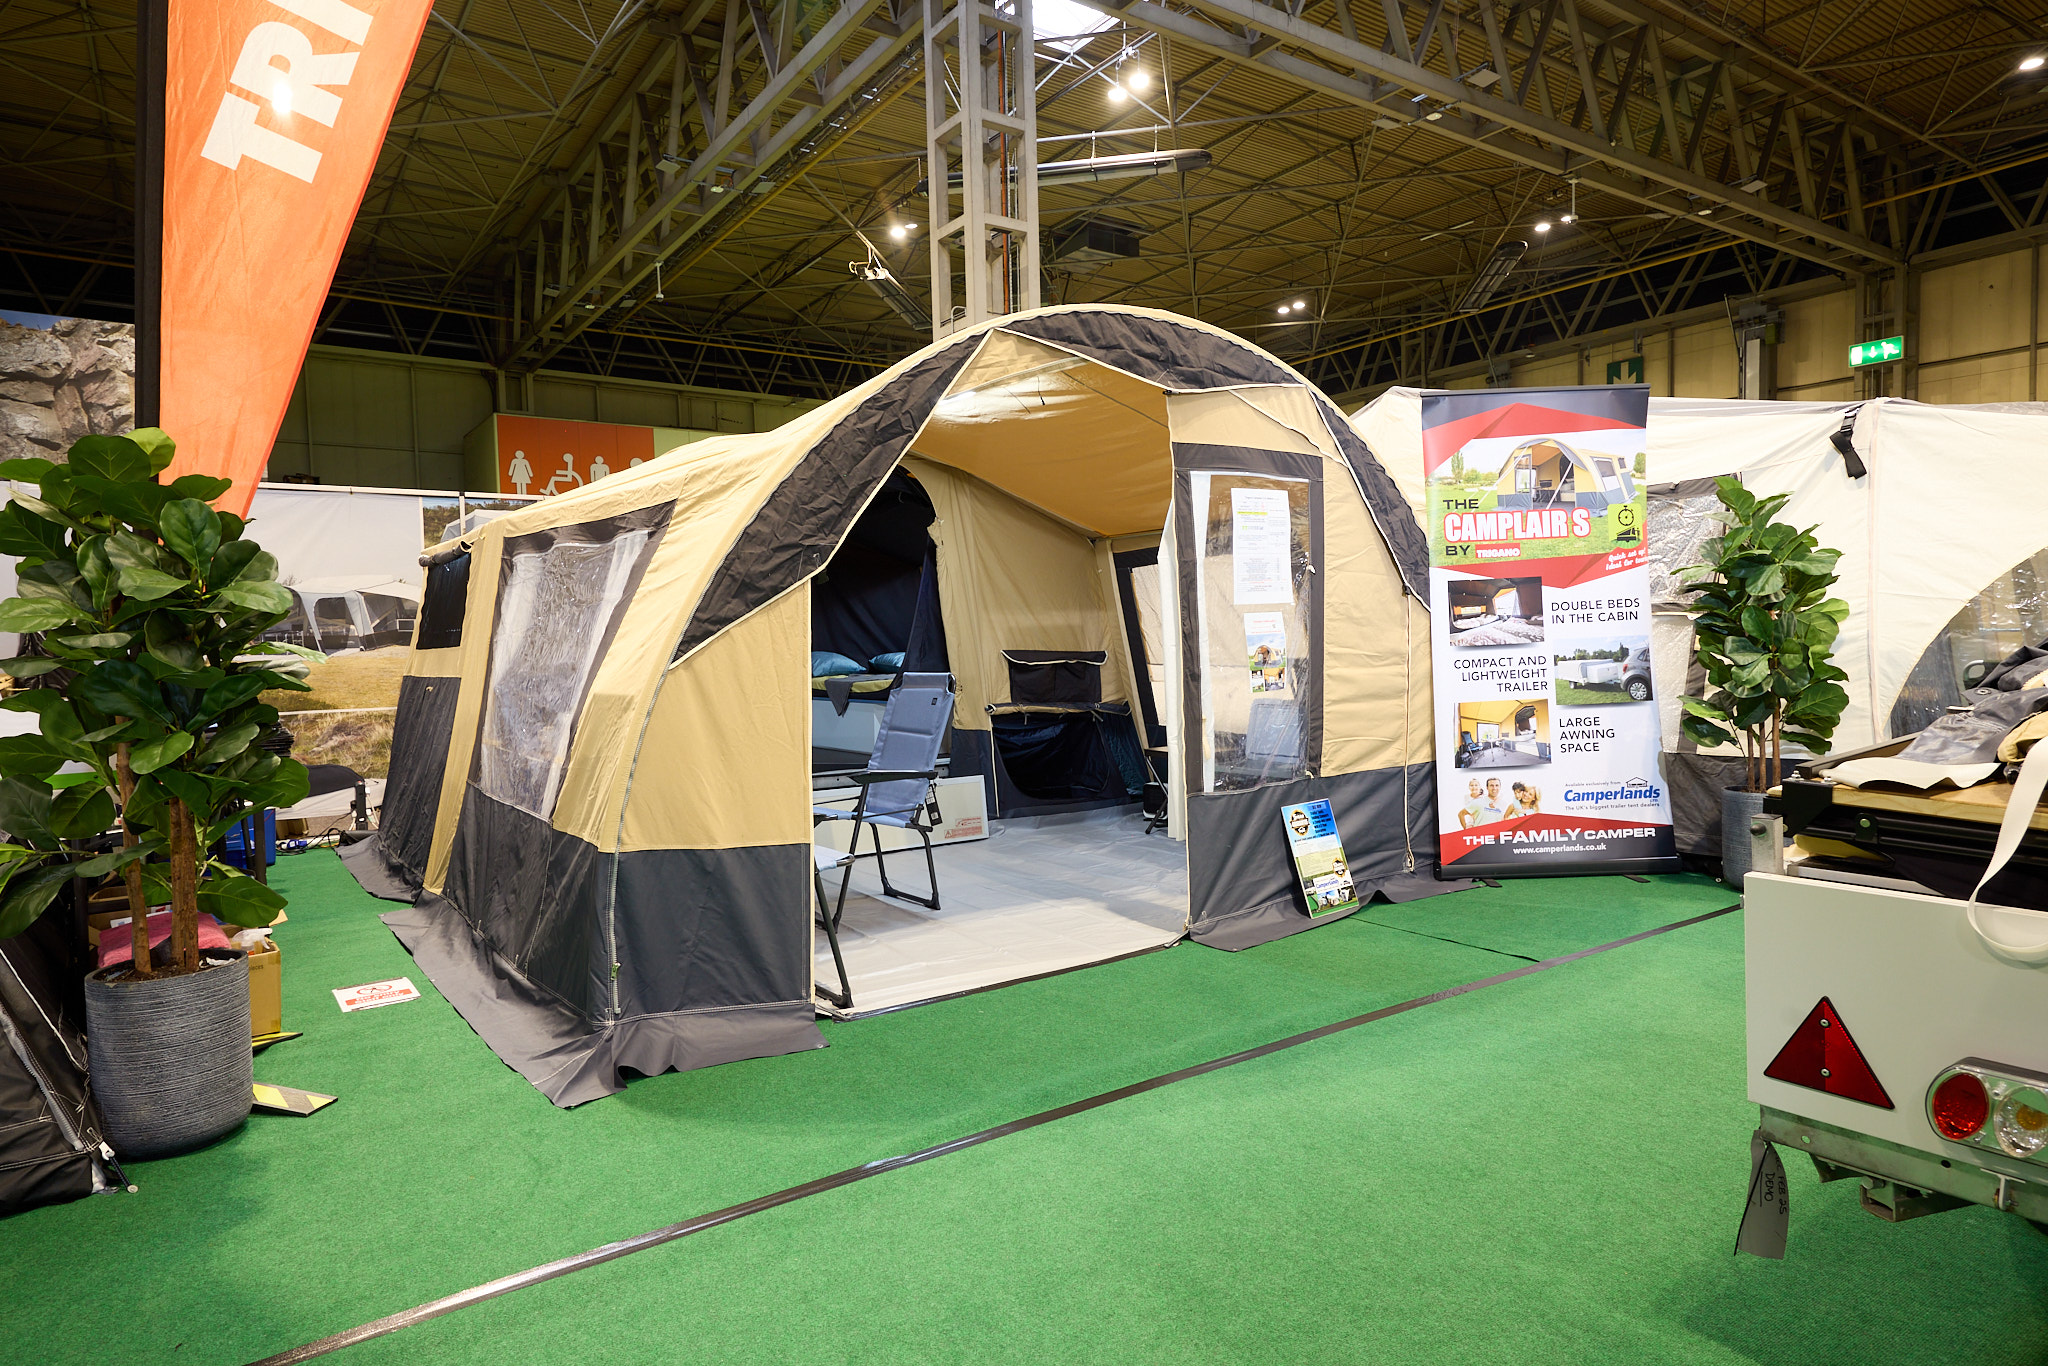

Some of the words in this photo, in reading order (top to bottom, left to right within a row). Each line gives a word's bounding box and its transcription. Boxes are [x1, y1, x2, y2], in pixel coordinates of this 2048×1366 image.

[1443, 498, 1479, 509] THE
[1444, 509, 1569, 543] CAMPLAIR
[1571, 507, 1591, 538] S
[1445, 545, 1470, 556] BY
[1476, 547, 1520, 558] TRIGANO
[1608, 552, 1626, 563] Quick
[1551, 600, 1602, 611] DOUBLE
[1607, 598, 1640, 609] BEDS
[1551, 614, 1565, 624] IN
[1569, 613, 1593, 623] THE
[1598, 611, 1638, 622] CABIN
[1454, 657, 1513, 669] COMPACT
[1518, 655, 1547, 666] AND
[1461, 668, 1547, 682] LIGHTWEIGHT
[1496, 681, 1548, 692] TRAILER
[1559, 716, 1600, 728] LARGE
[1560, 728, 1615, 741] AWNING
[1560, 742, 1600, 753] SPACE
[1563, 785, 1660, 804] Camperlands
[1463, 835, 1495, 846] THE
[1499, 828, 1581, 844] FAMILY
[1584, 828, 1656, 840] CAMPER
[1513, 843, 1607, 855] www.camperlands.co.uk
[1764, 1172, 1775, 1201] DEMO
